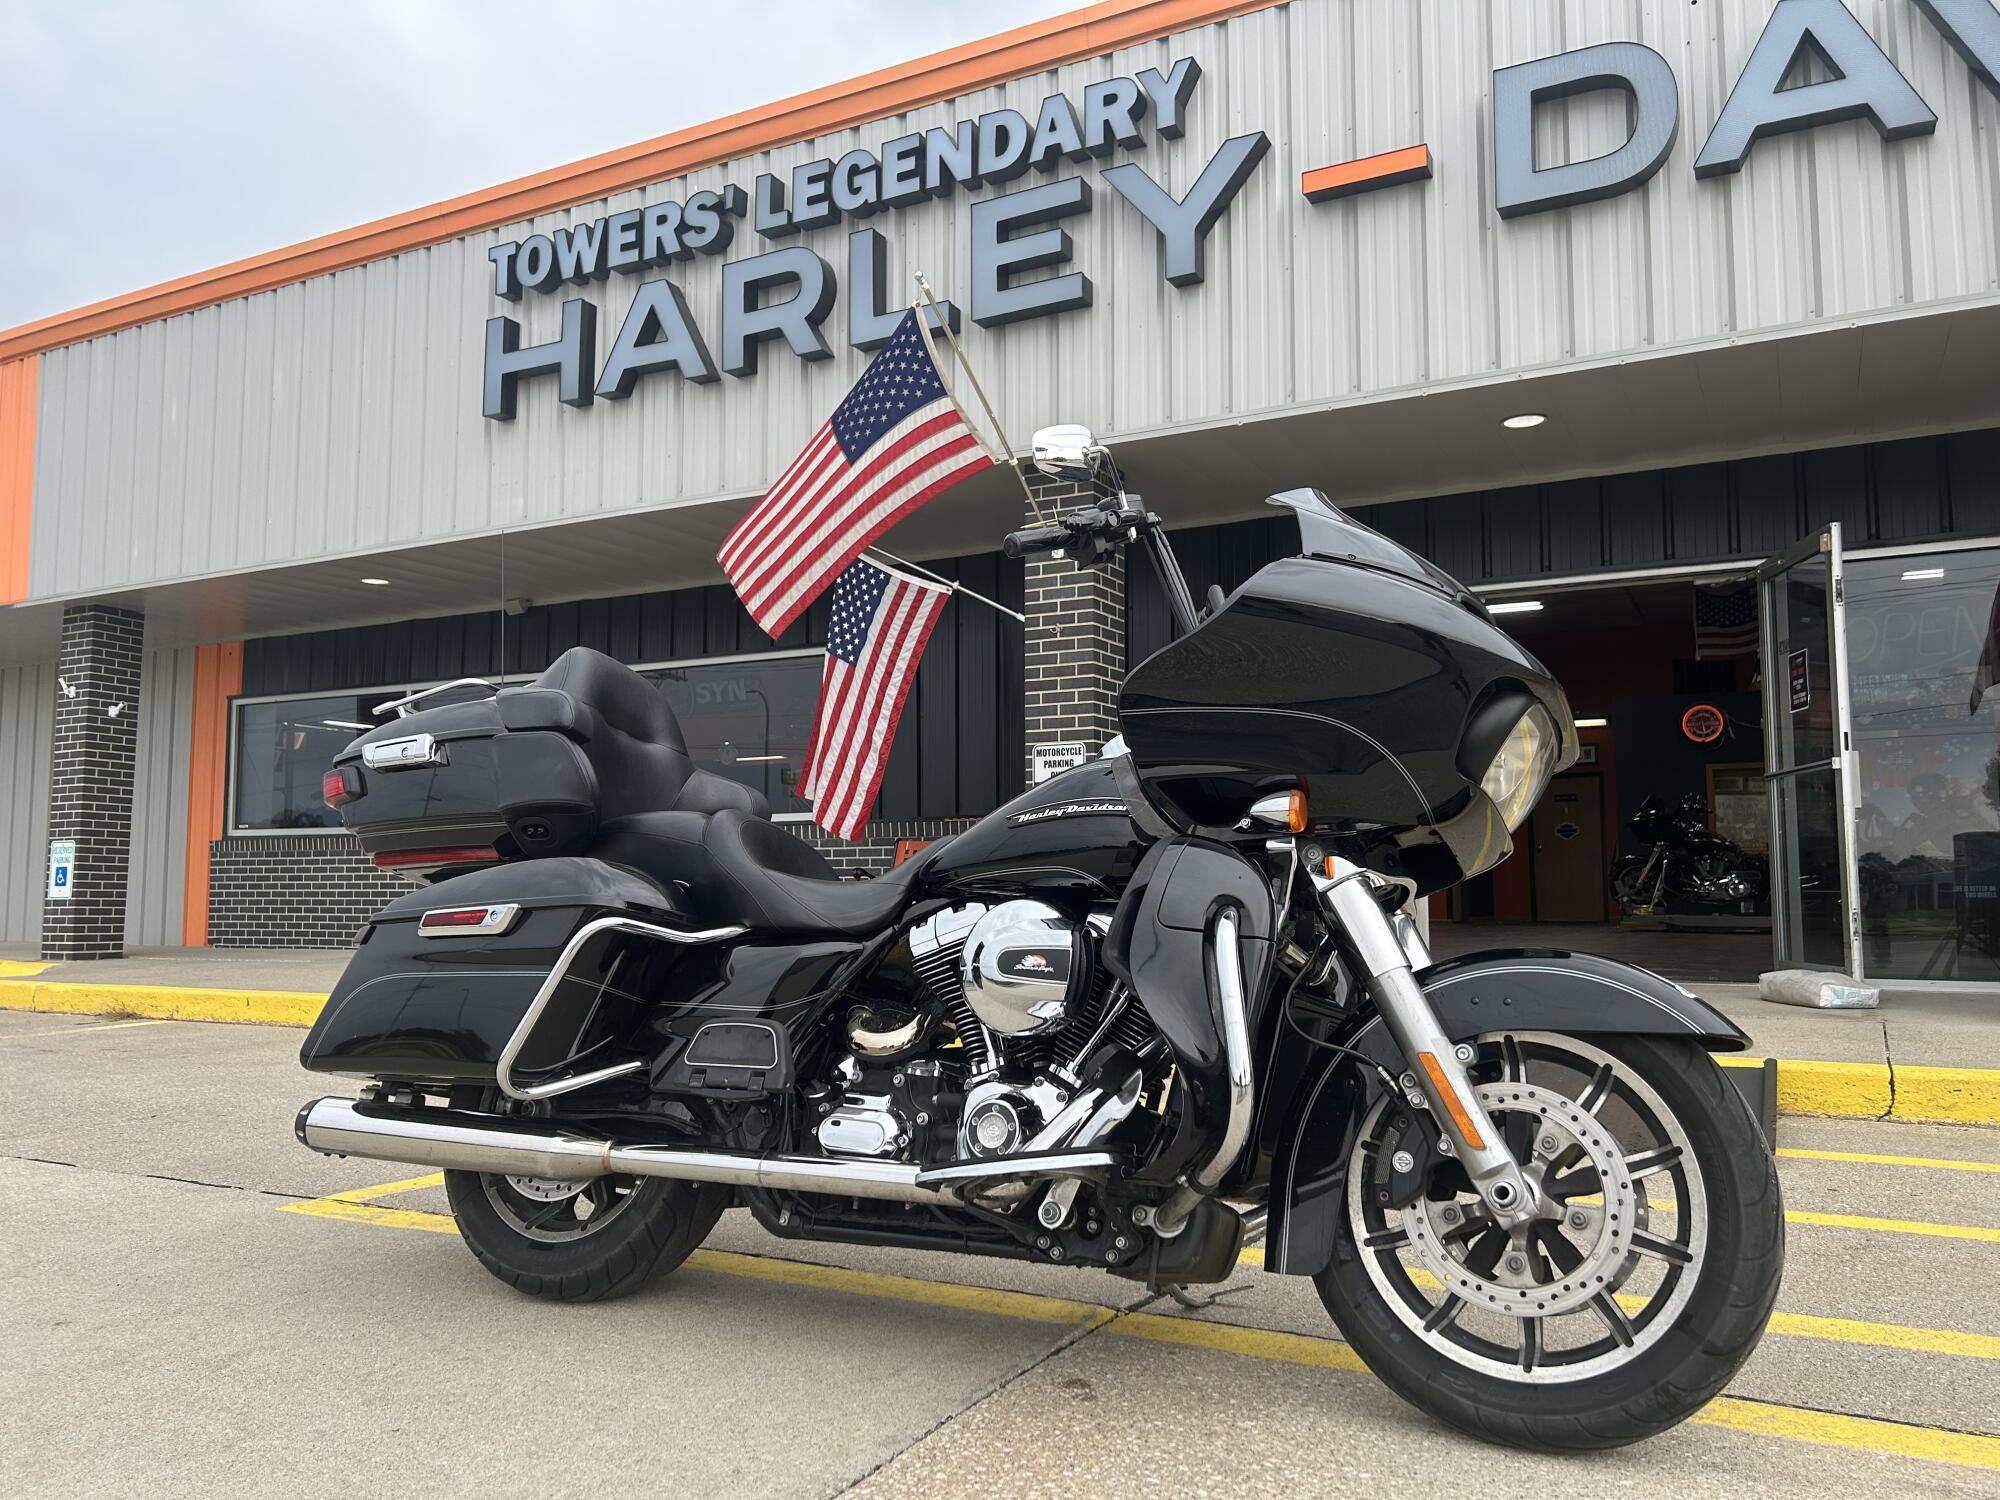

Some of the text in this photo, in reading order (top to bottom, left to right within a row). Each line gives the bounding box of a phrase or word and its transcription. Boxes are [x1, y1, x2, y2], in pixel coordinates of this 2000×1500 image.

[489, 57, 1202, 302] TOWERS' LEGENDARY
[1036, 746, 1082, 757] MOTORCYCLE
[1044, 759, 1075, 768] PARKING
